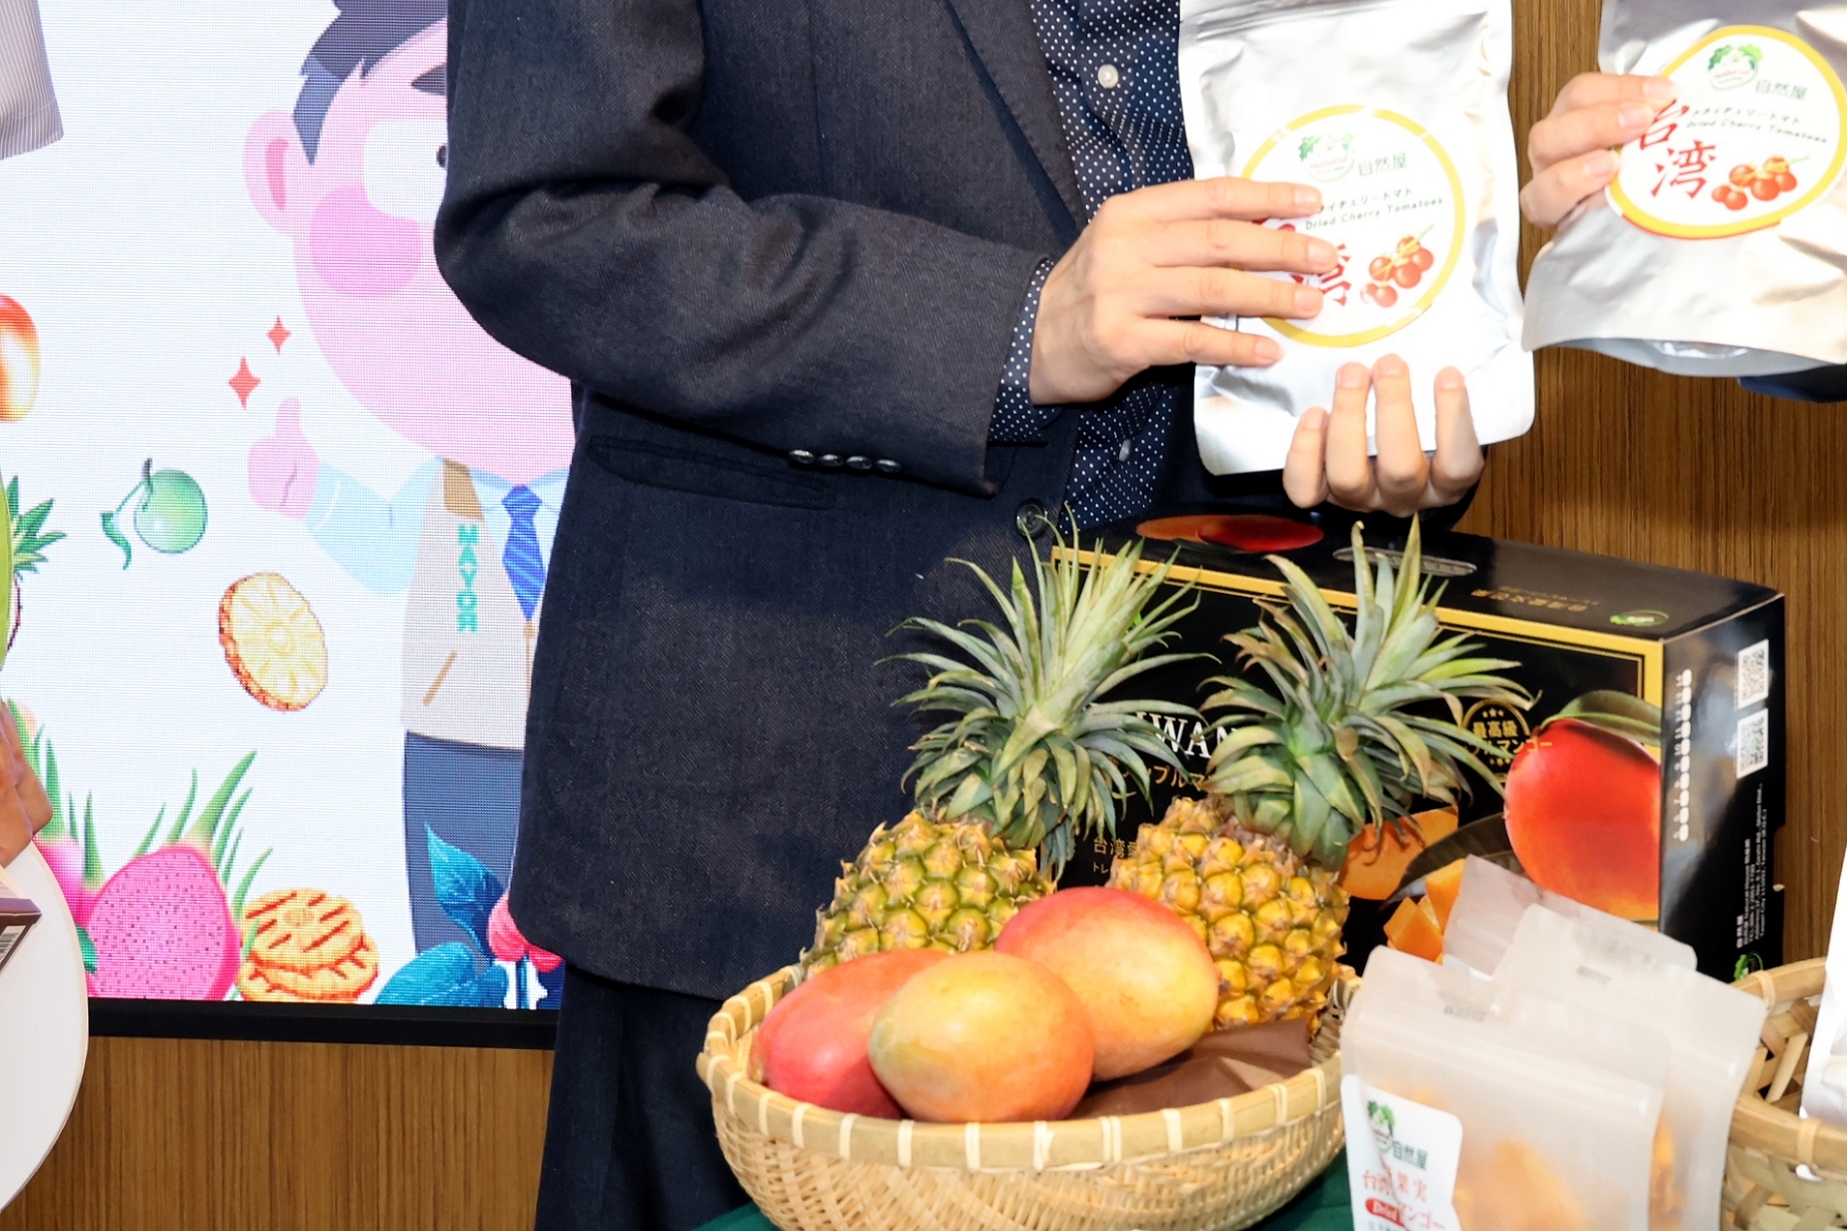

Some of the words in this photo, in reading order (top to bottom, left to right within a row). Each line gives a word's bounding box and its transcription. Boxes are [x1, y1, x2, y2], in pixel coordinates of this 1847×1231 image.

[1755, 79, 1808, 100] 自然屋
[1358, 152, 1408, 176] 自然屋
[1306, 217, 1336, 231] Dried
[1341, 208, 1381, 223] Cherry
[1387, 197, 1443, 214] Tomatoes
[456, 523, 480, 633] MAYOR
